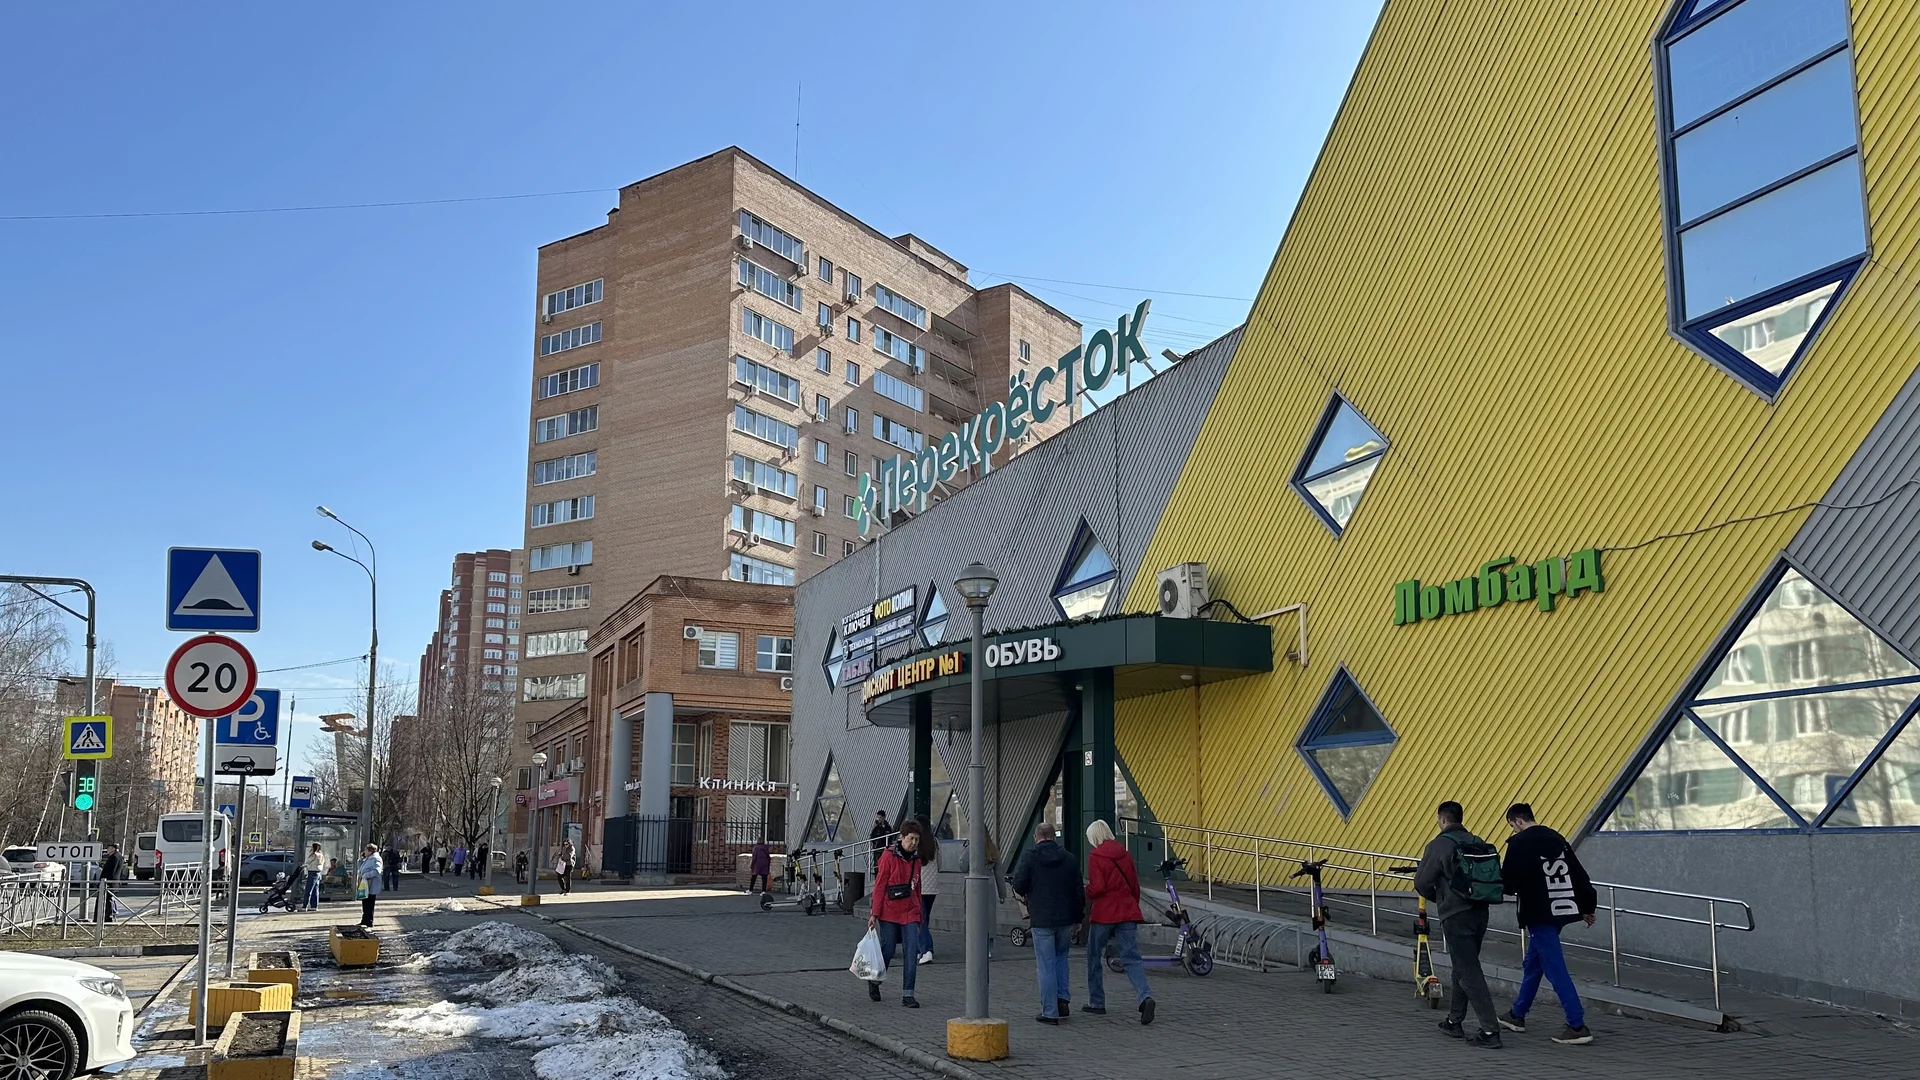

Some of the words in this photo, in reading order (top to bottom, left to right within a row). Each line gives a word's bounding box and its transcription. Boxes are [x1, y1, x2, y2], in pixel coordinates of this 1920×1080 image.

[881, 299, 1151, 519] Перекрёсток
[1393, 548, 1604, 627] Ломбард
[985, 637, 1060, 668] ОБУВЬ
[187, 661, 237, 694] 20
[863, 669, 895, 704] ДИСКОНТ
[898, 657, 936, 690] ЦЕНТР
[938, 651, 961, 677] №1
[78, 777, 95, 793] 38
[46, 845, 93, 859] СТОП
[1540, 851, 1580, 916] DIES
